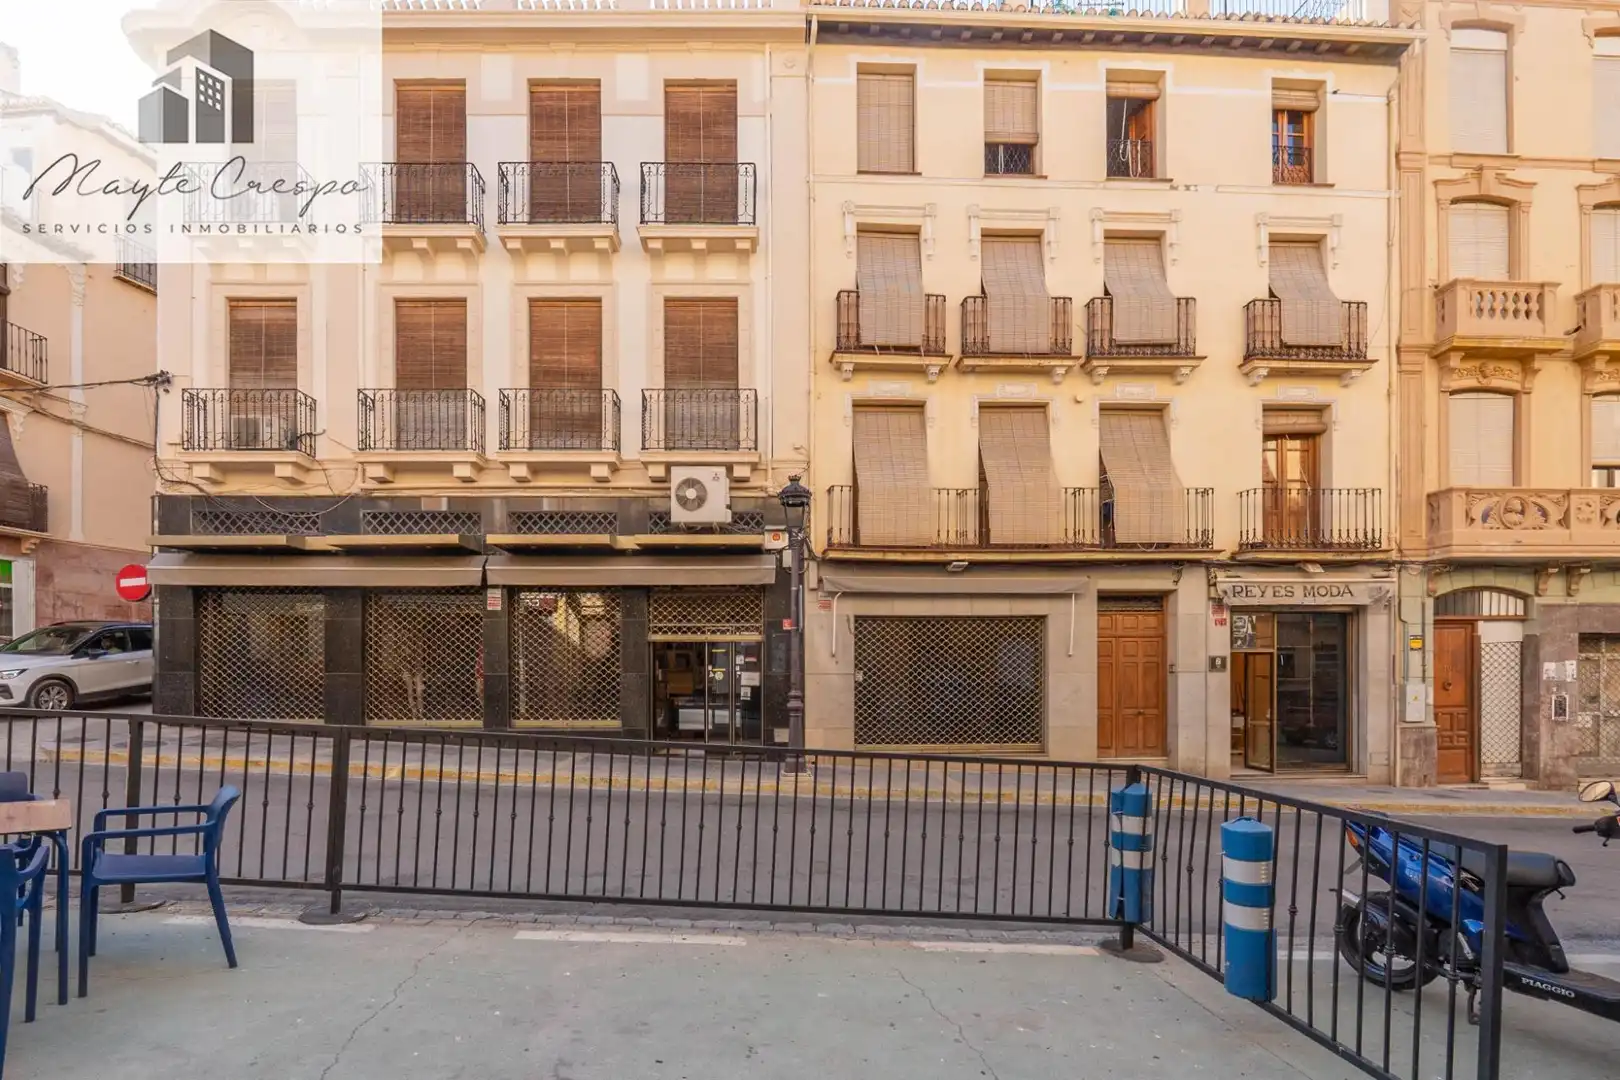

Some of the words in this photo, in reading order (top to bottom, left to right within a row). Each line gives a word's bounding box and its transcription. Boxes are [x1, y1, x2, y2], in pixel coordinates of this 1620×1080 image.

[1232, 585, 1294, 598] REYES
[1303, 585, 1354, 598] MODA
[1521, 978, 1575, 998] PIAGGIO
